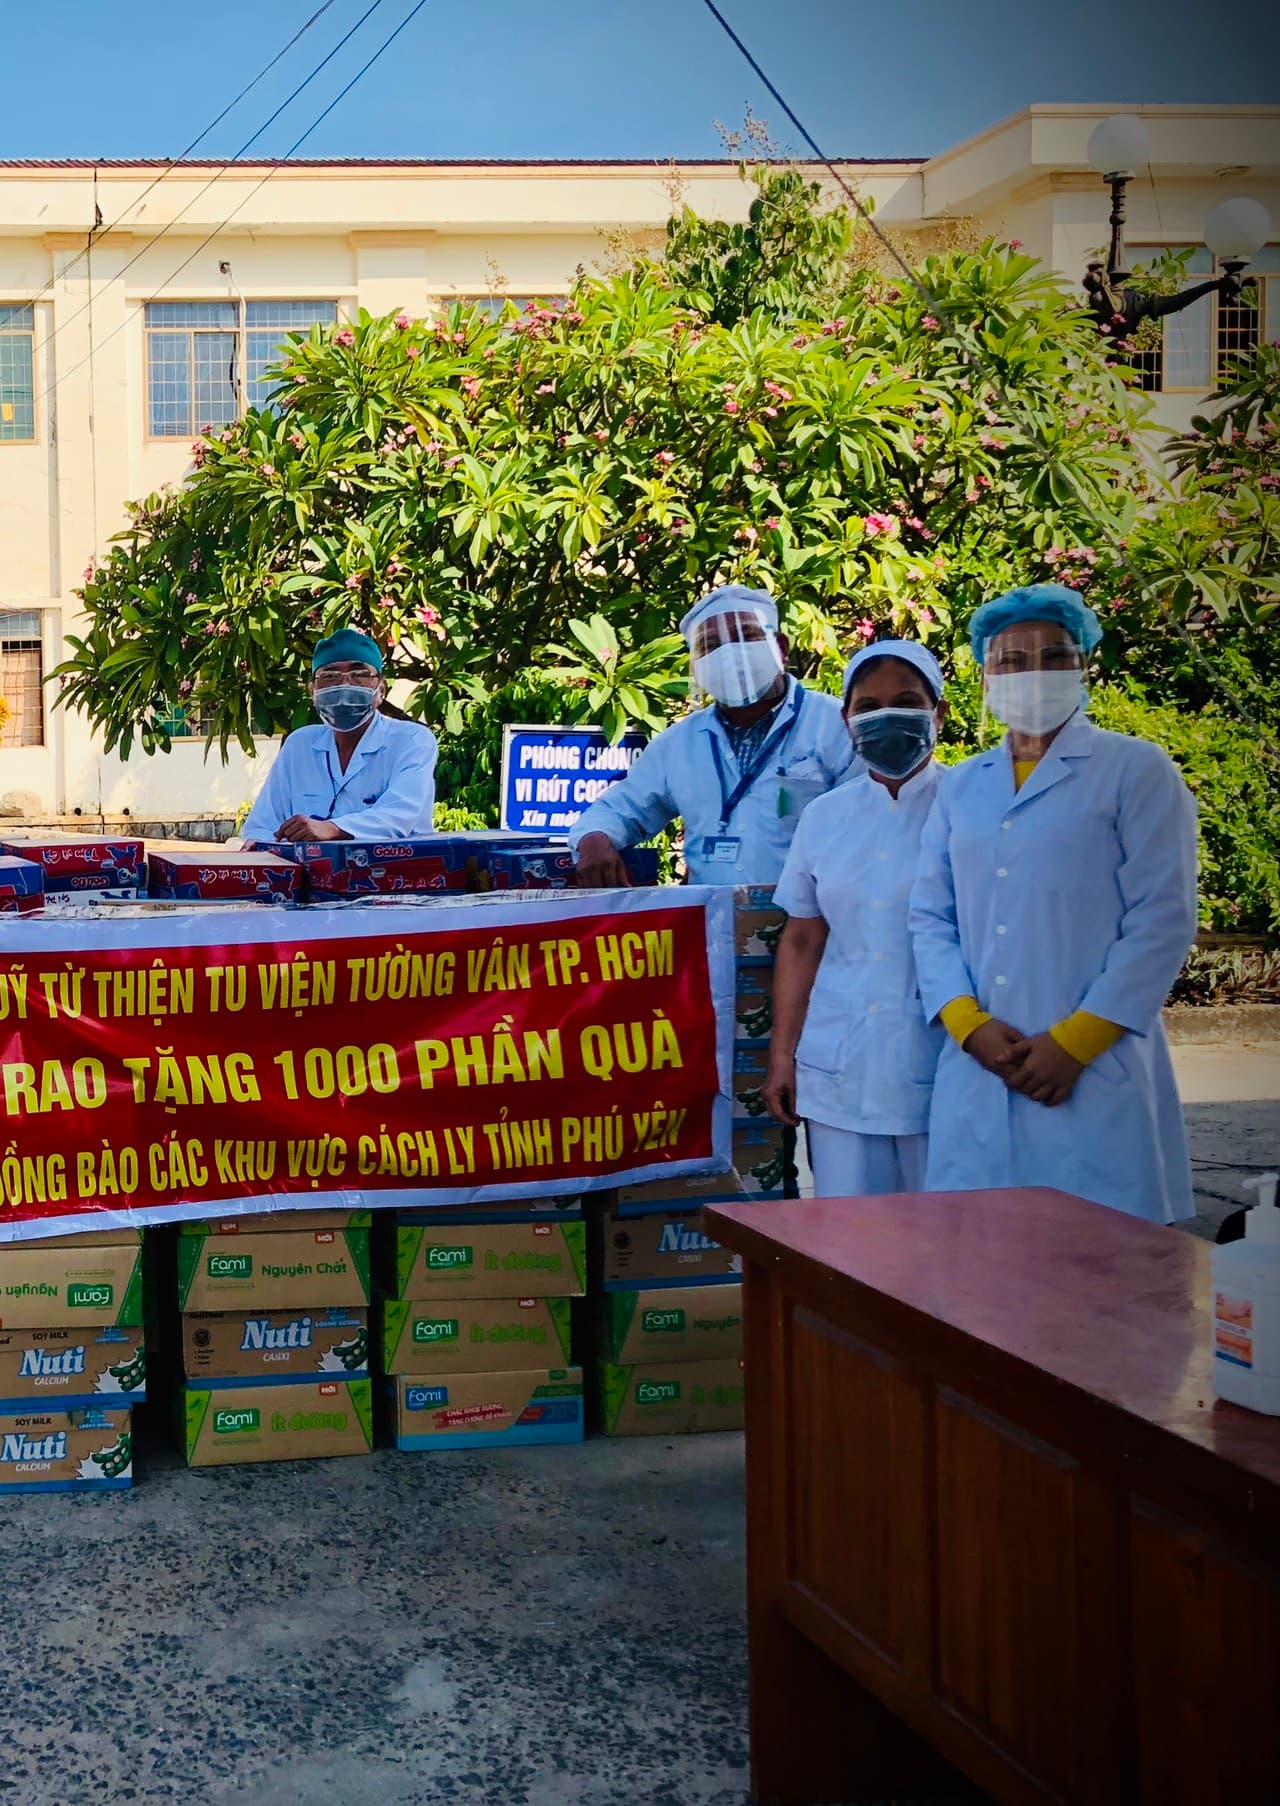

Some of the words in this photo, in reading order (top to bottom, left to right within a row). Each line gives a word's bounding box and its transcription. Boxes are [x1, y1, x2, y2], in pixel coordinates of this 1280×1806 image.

[519, 739, 581, 770] PHÒNG
[515, 778, 533, 802] VI
[536, 773, 571, 802] RÚT
[519, 809, 548, 827] Xin
[39, 961, 86, 1019] TỪ
[93, 957, 195, 1026] THIỆN
[205, 966, 248, 1013] TU
[258, 951, 336, 1018] VIỆN
[346, 943, 456, 1002] TƯỜNG
[466, 936, 531, 994] VÂN
[539, 938, 590, 987] TP.
[595, 929, 674, 983] HCM
[122, 1045, 262, 1114] TẶNG
[273, 1042, 401, 1101] 1000
[414, 1014, 565, 1090] PHẦN
[579, 1008, 685, 1082] QUÀ
[76, 1138, 140, 1199] BÀO
[148, 1129, 209, 1193] CÁC
[214, 1139, 276, 1185] KHU
[287, 1133, 348, 1188] VỰC
[357, 1123, 440, 1178] CÁCH
[443, 1125, 475, 1177] LY
[482, 1105, 552, 1170] TỈNH
[561, 1105, 623, 1163] PHÚ
[631, 1100, 688, 1154] YÊN
[210, 1256, 246, 1271] Fami
[261, 1263, 313, 1278] Nguyên
[316, 1257, 347, 1275] Chất
[5, 1282, 58, 1299] Nguyên
[73, 1290, 110, 1305] Fami
[32, 1332, 48, 1341] SOY
[49, 1331, 69, 1340] MILK
[239, 1316, 313, 1351] Nuti
[18, 1345, 86, 1377] Nuti
[15, 1418, 31, 1427] SOY
[32, 1416, 52, 1426] MILK
[216, 1411, 254, 1427] Fami
[0, 1431, 67, 1463] Nuti
